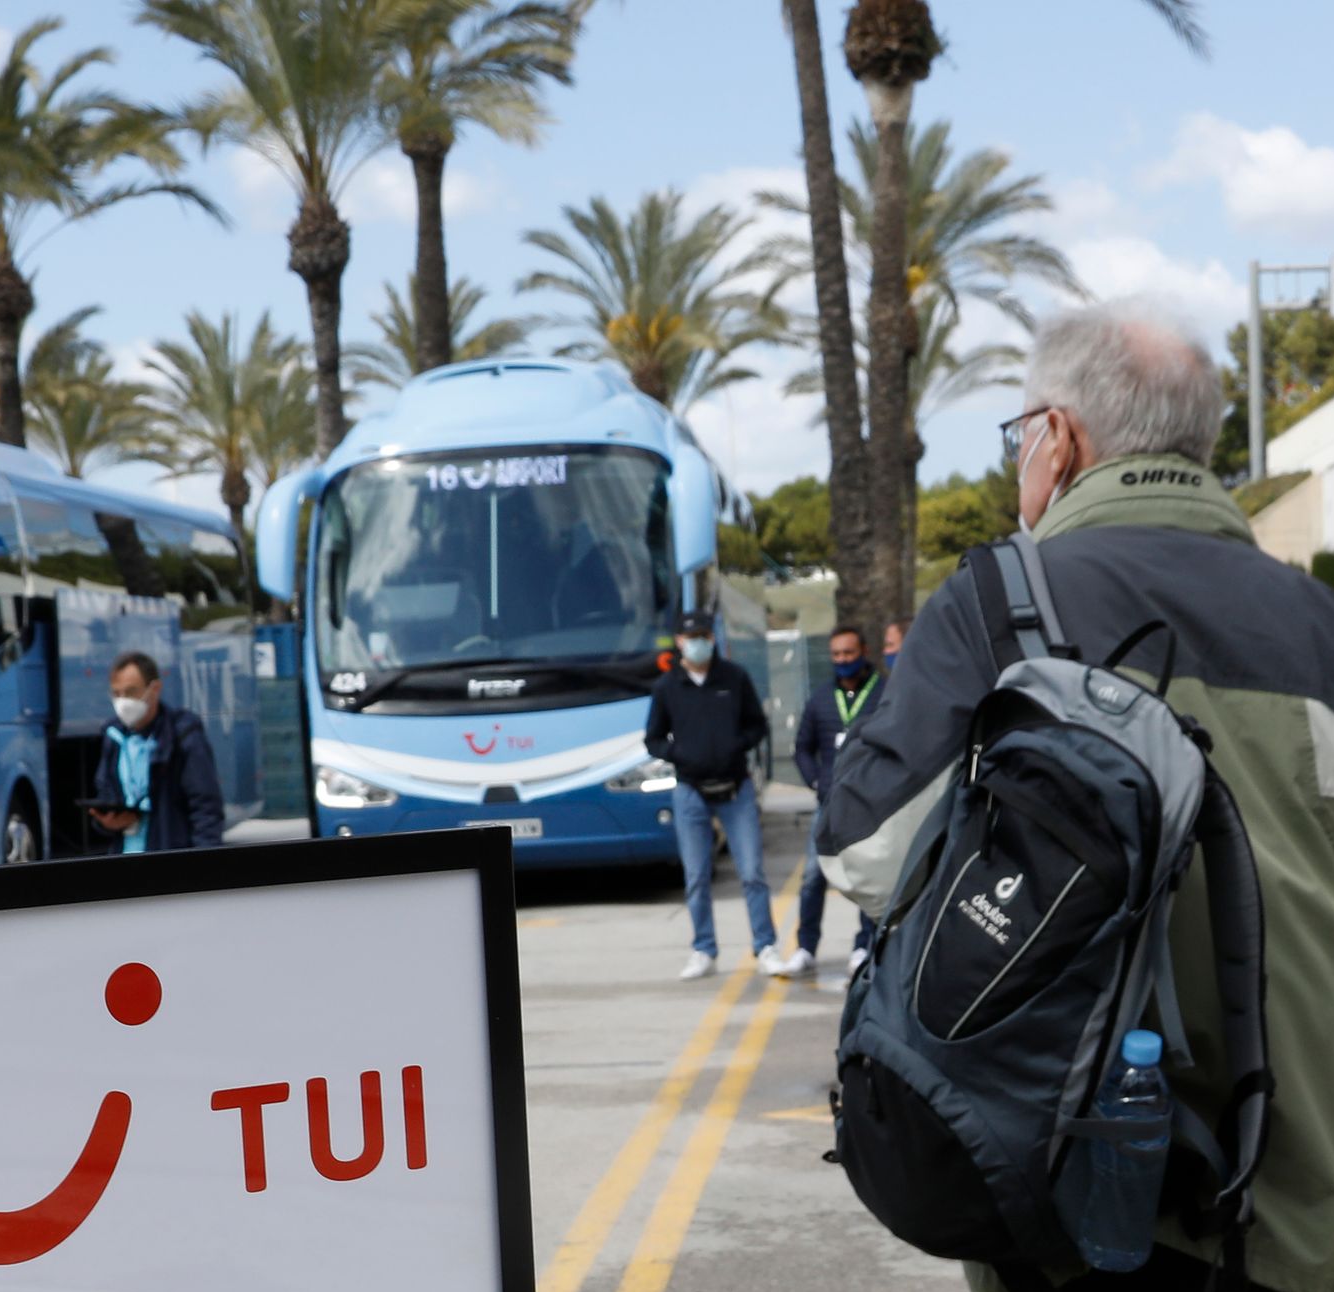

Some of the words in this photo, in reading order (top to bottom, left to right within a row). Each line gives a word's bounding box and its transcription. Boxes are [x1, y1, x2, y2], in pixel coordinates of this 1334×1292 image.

[425, 464, 459, 491] 16
[1141, 469, 1202, 487] HI-TEC
[210, 1065, 428, 1193] TUI
